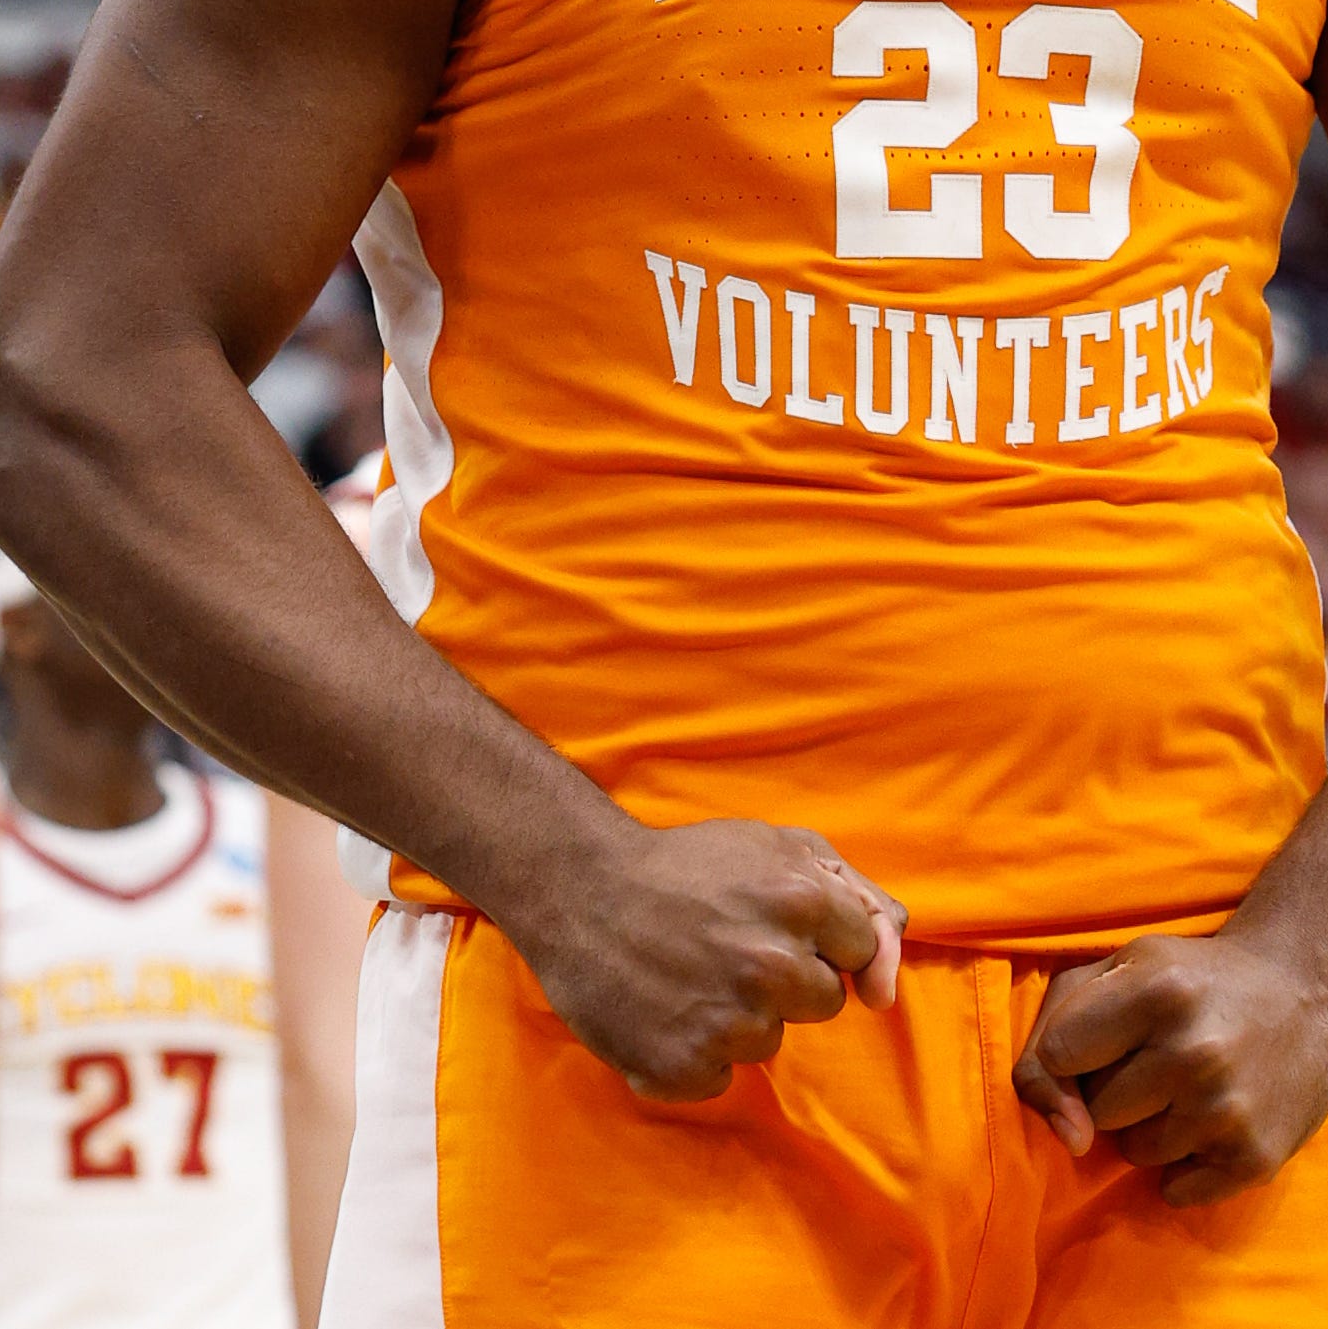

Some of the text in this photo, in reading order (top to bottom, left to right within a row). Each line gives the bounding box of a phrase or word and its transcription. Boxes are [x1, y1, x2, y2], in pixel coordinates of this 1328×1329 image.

[832, 1, 1144, 260] 23
[645, 249, 1230, 446] VOLUNTEERS
[59, 1050, 221, 1181] 27
